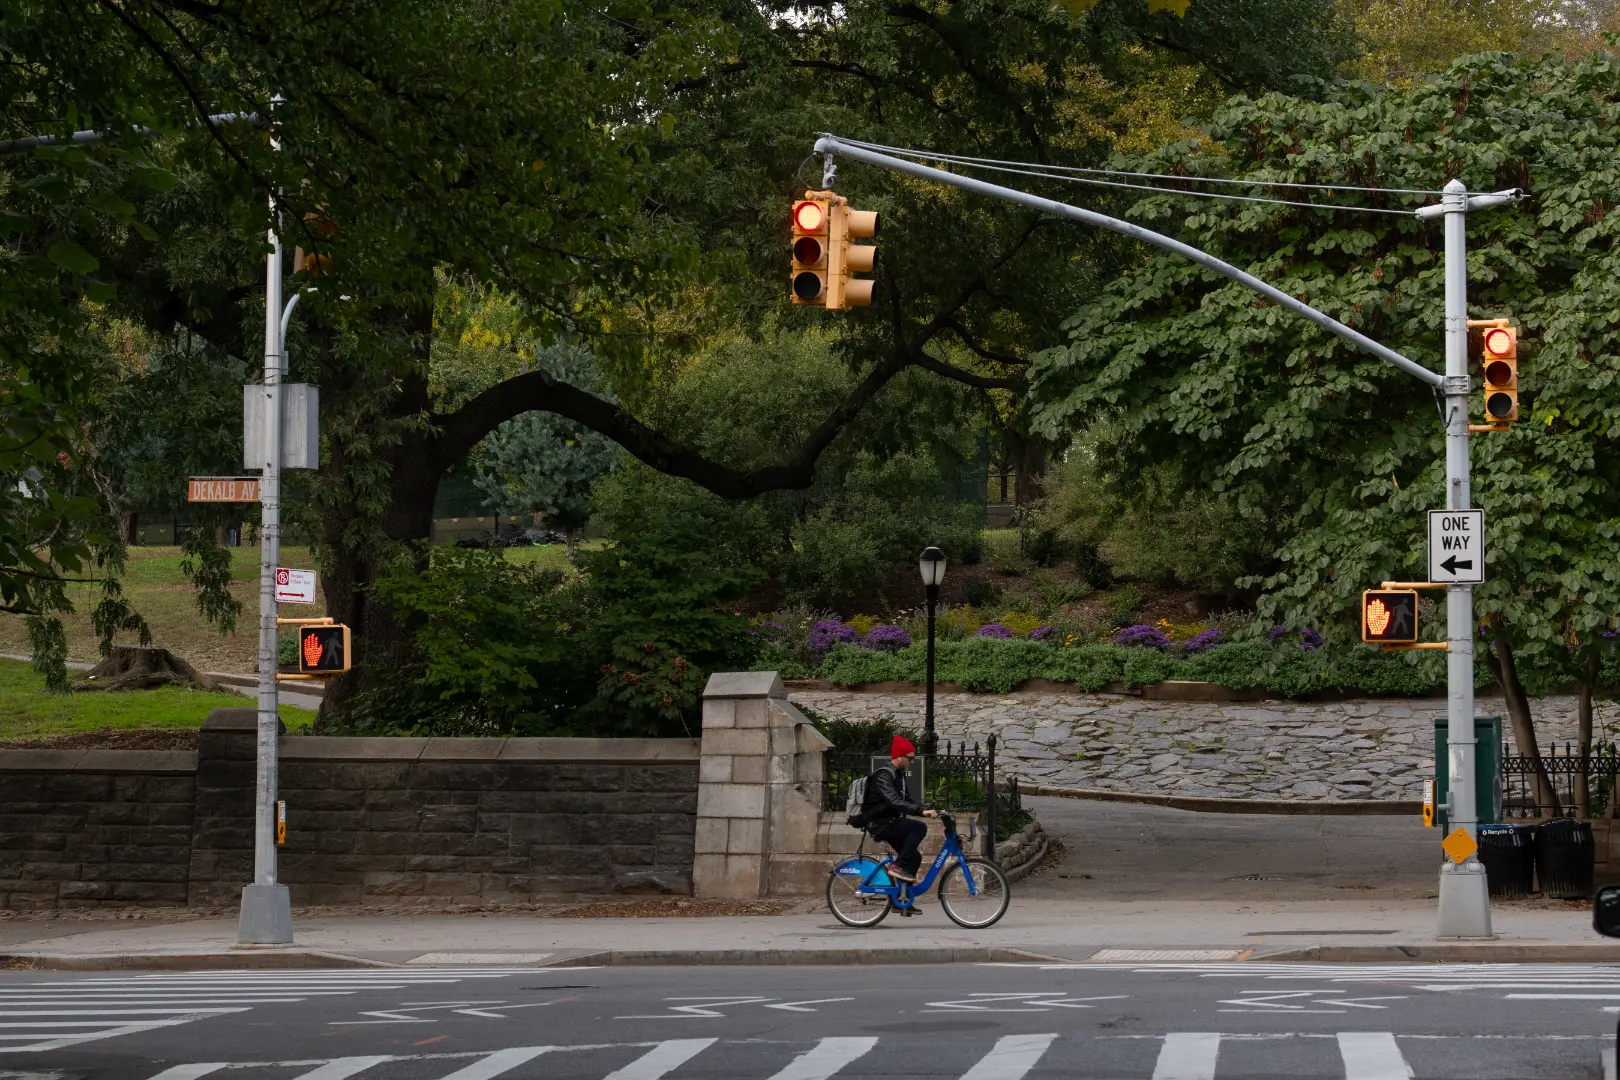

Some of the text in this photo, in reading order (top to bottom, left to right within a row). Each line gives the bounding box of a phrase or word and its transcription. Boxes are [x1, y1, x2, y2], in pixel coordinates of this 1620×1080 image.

[193, 481, 255, 500] DEKALB AV
[1442, 516, 1470, 531] ONE
[1441, 535, 1470, 550] WAY
